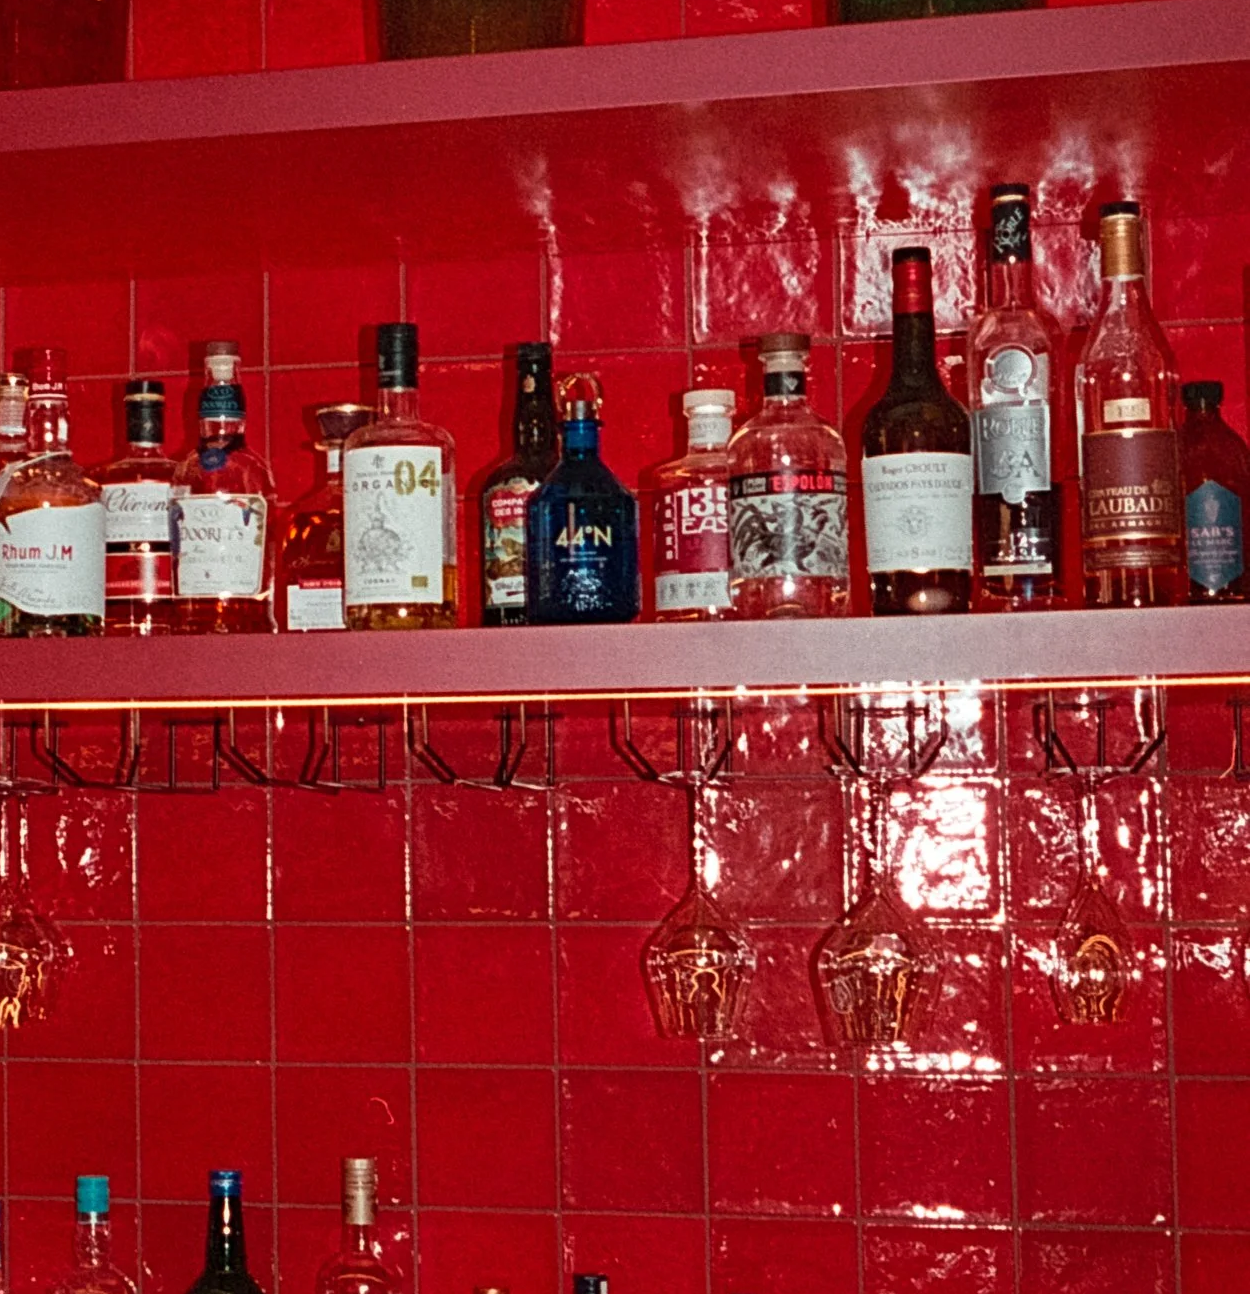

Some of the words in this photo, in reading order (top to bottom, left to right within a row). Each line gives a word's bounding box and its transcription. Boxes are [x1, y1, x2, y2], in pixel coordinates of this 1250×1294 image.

[394, 459, 440, 497] 04
[1089, 497, 1174, 516] LAUBADE
[681, 515, 728, 535] EAS
[555, 526, 612, 547] 44°N
[2, 544, 41, 560] Rhum
